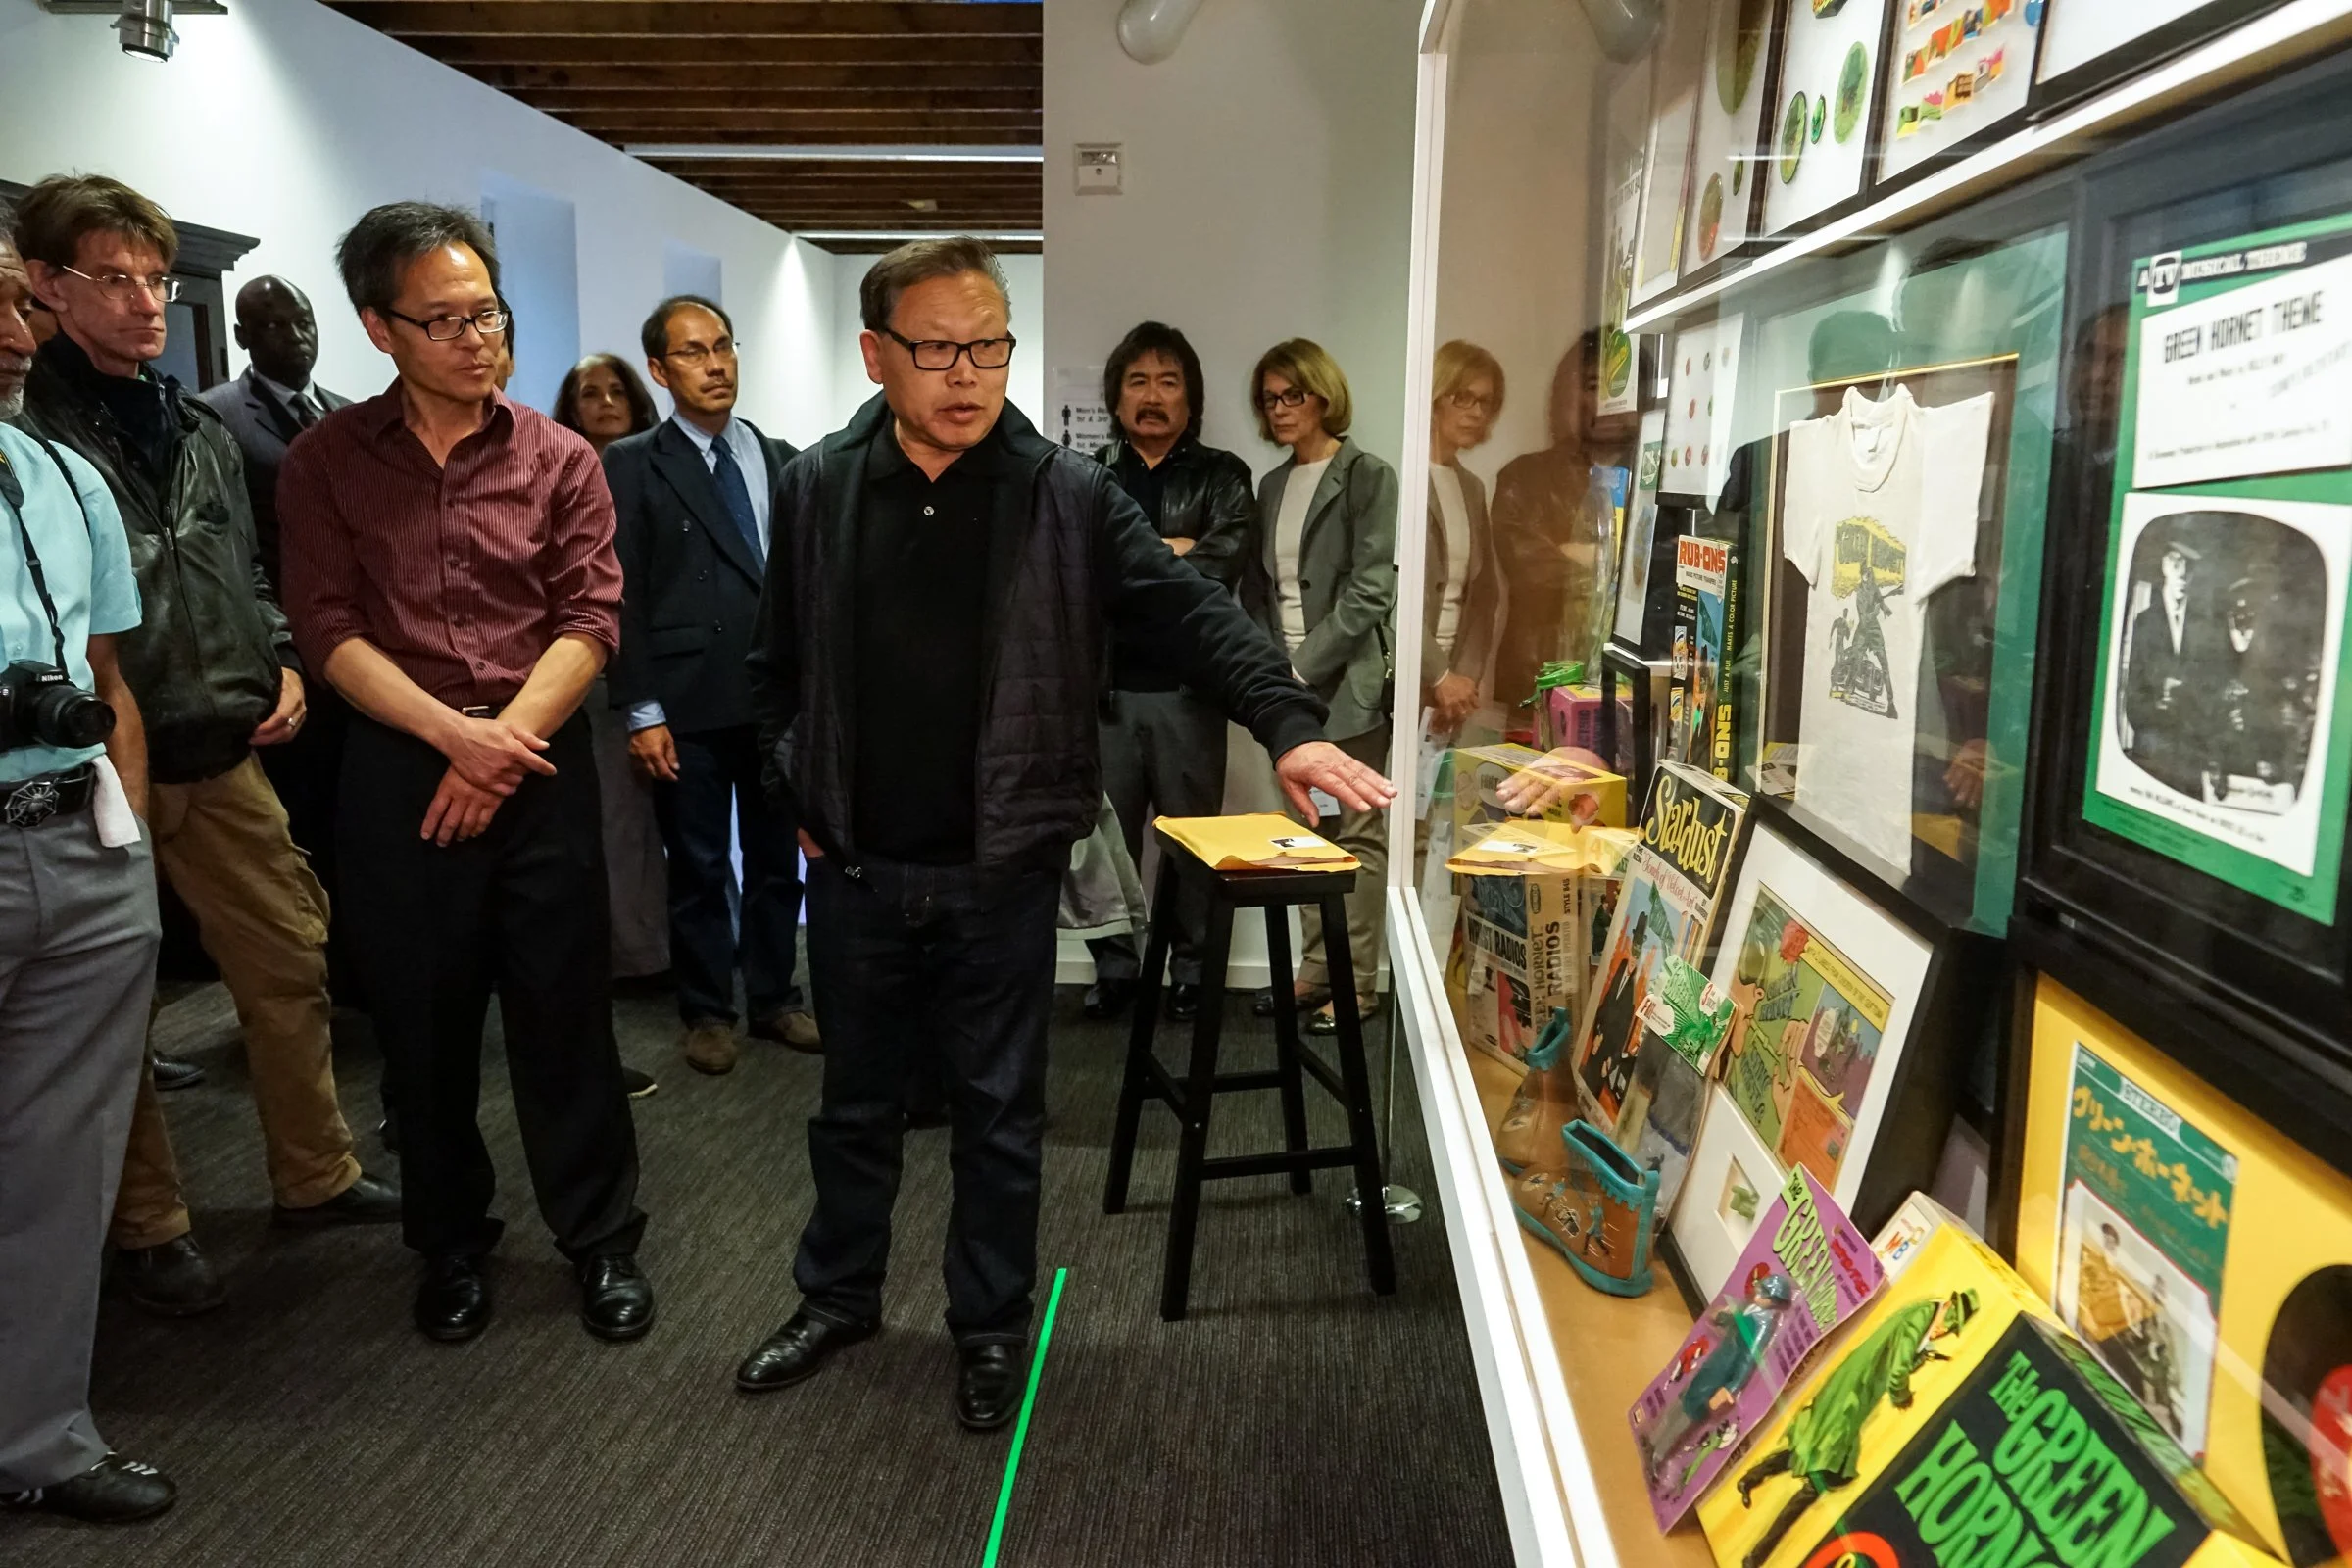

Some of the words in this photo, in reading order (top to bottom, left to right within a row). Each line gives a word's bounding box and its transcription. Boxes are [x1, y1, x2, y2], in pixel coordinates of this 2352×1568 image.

[2164, 325, 2203, 364] GREEN
[2210, 307, 2264, 351] HORNET
[2271, 290, 2326, 335] THEME
[1678, 541, 1726, 574] RUB-ONS
[1713, 704, 1732, 782] B-ONS
[1645, 775, 1728, 884] Stardust
[1494, 930, 1527, 971] RADIOS
[1545, 921, 1562, 997] RADIOS
[1772, 1198, 1833, 1279] GREEN
[1894, 1419, 2063, 1568] HORN
[1992, 1388, 2177, 1568] GREEN
